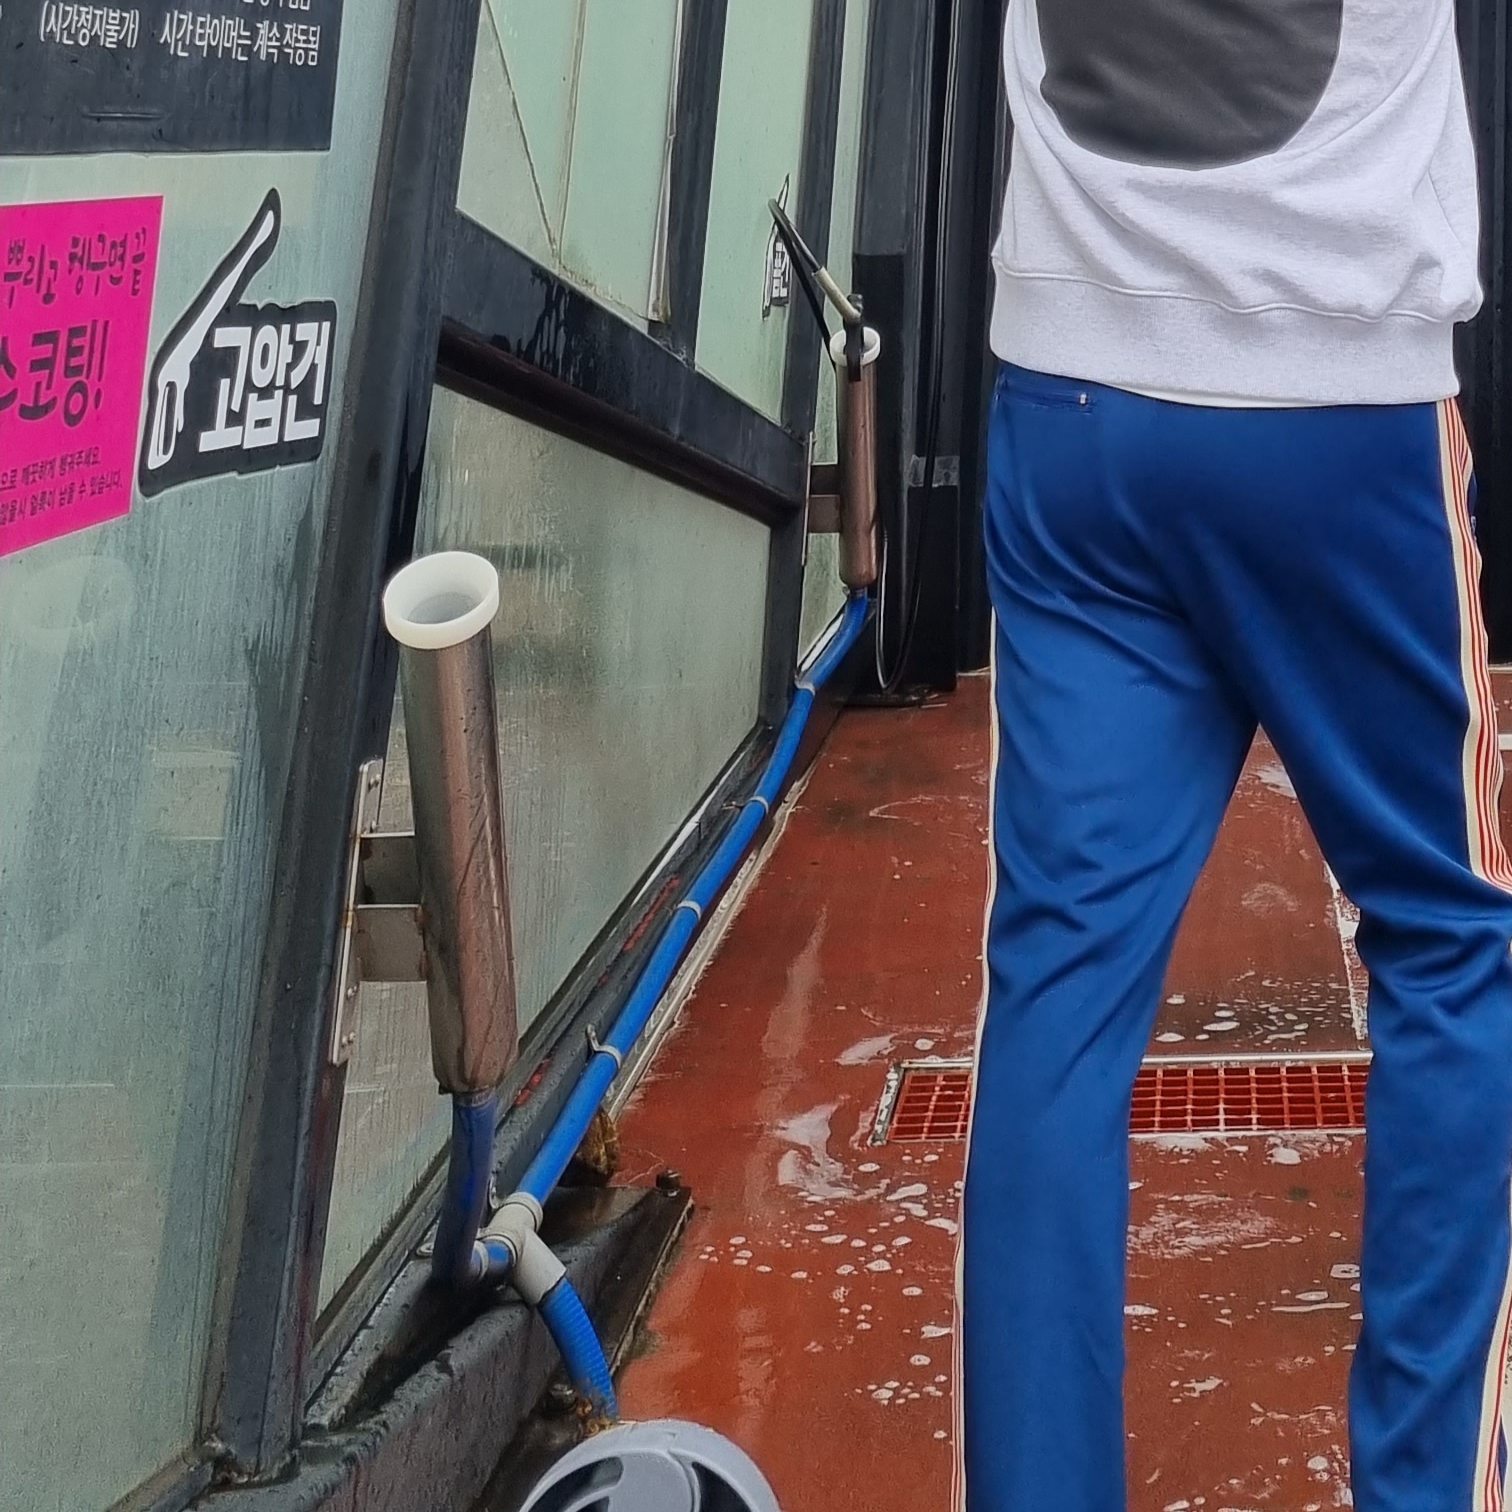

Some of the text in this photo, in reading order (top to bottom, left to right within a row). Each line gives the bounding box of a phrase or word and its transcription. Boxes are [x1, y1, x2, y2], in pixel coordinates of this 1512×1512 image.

[40, 0, 320, 65] (시간정지불가) 시간 타이머는 계속 작동됨
[4, 227, 147, 309] 뿌리고 헹구면 끝
[198, 320, 332, 453] 고압건
